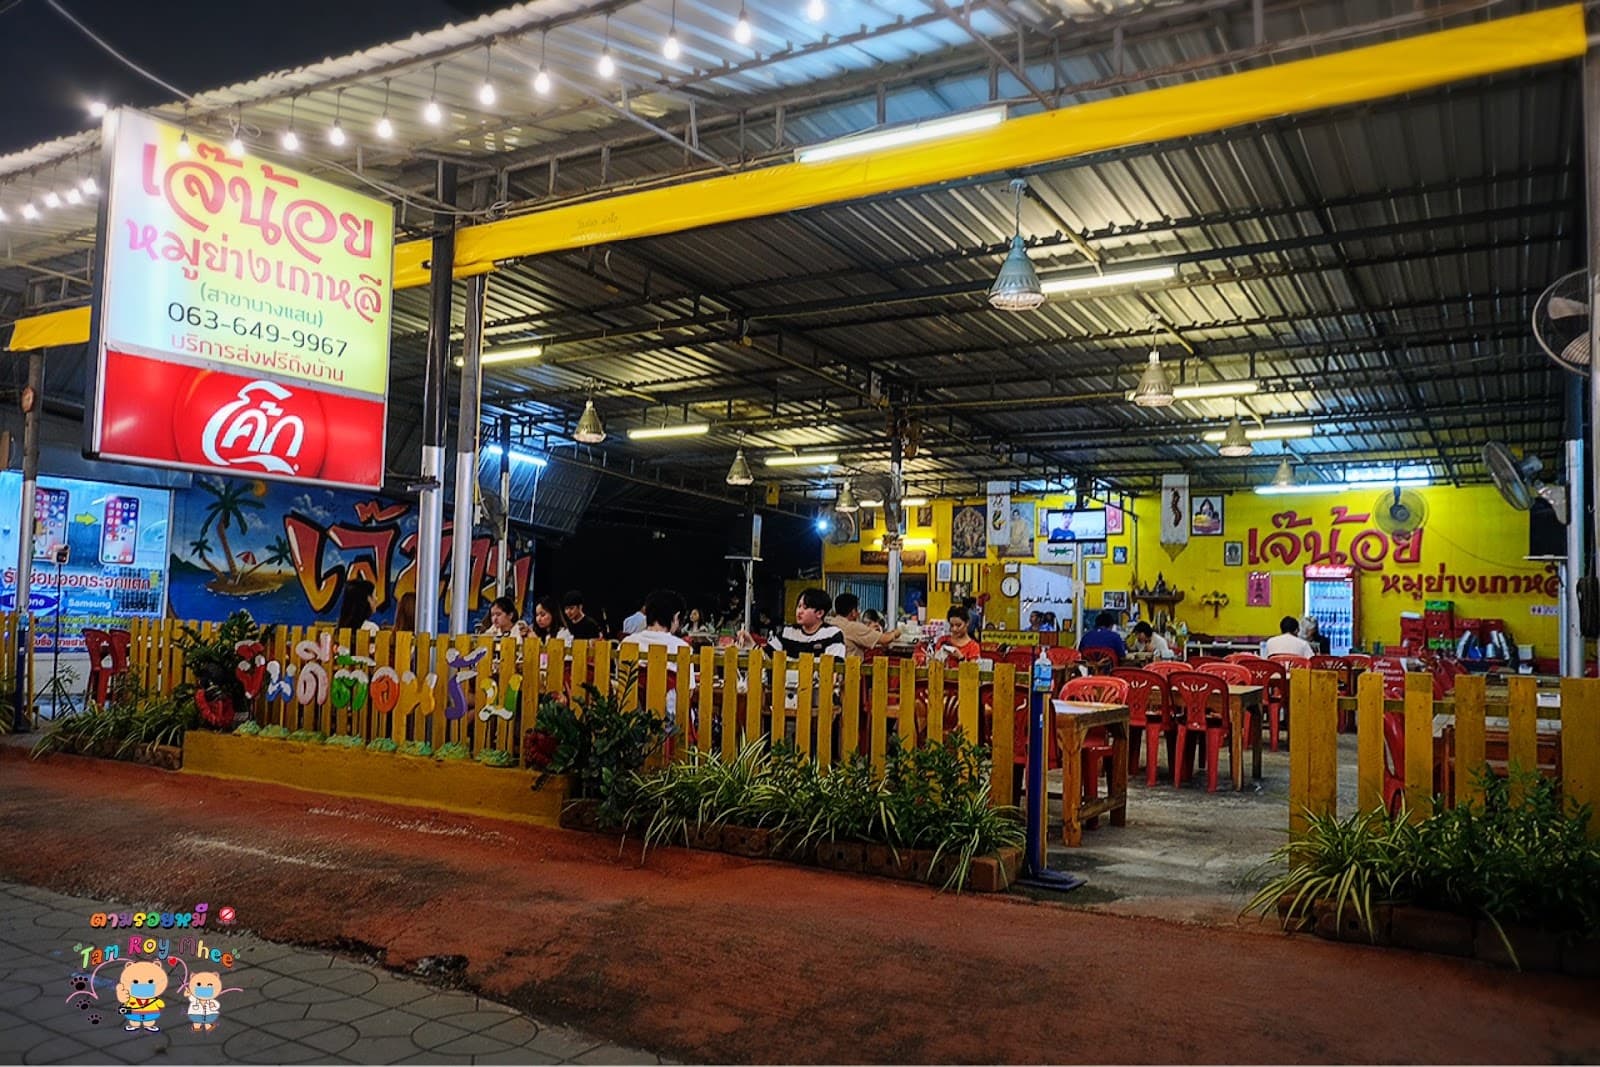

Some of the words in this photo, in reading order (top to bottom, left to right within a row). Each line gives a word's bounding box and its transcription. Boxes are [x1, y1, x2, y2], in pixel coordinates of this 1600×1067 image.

[142, 142, 374, 264] เจ๊น้อย
[126, 217, 382, 323] หมูย่างเกาหลี
[168, 301, 348, 358] 063-649-9967
[200, 282, 324, 328] (สาขาบางแสน)
[171, 333, 345, 382] บริการส่งฟรีถึงบ้าน
[1248, 506, 1424, 571] เจ๊น้อย
[68, 598, 111, 610] Samsung
[234, 632, 523, 722] ยินดีต้อนรับ
